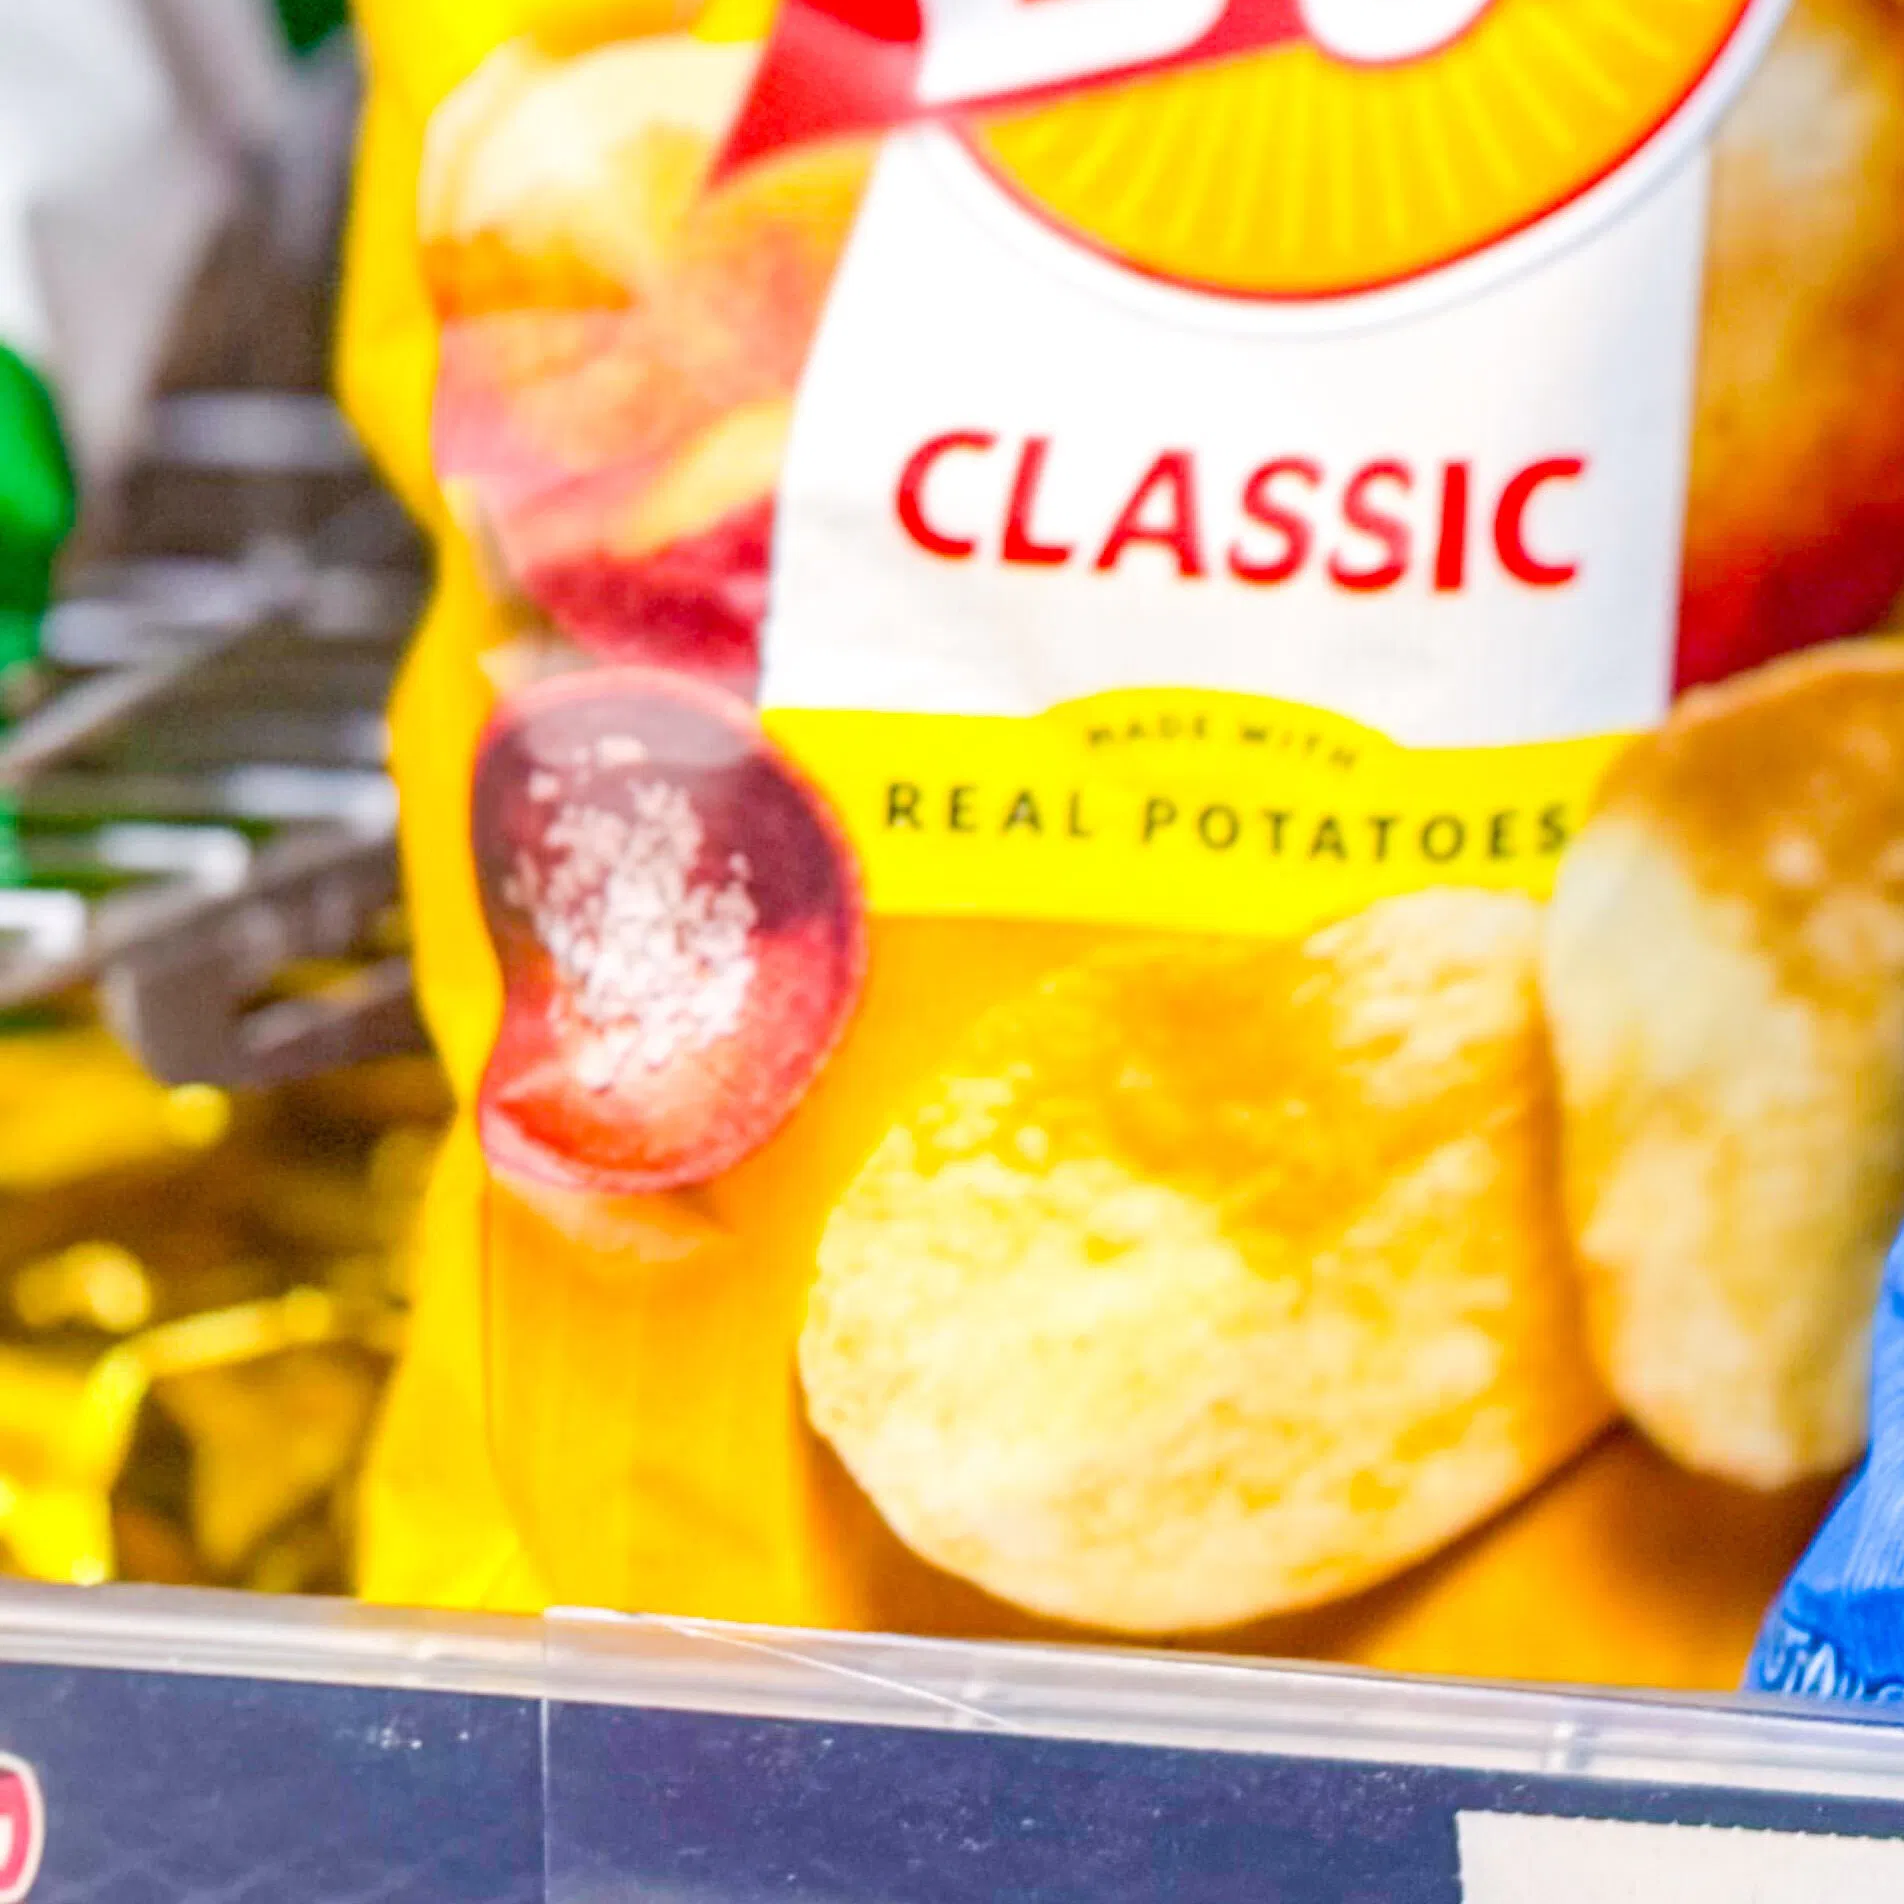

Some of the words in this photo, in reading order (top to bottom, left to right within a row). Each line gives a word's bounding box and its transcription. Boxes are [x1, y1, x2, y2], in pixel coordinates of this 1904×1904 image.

[895, 427, 1589, 595] CLASSIC
[1087, 714, 1210, 751] MADE
[1239, 722, 1359, 770] WITH
[884, 781, 1094, 840] REAL
[1142, 796, 1570, 863] POTATOES
